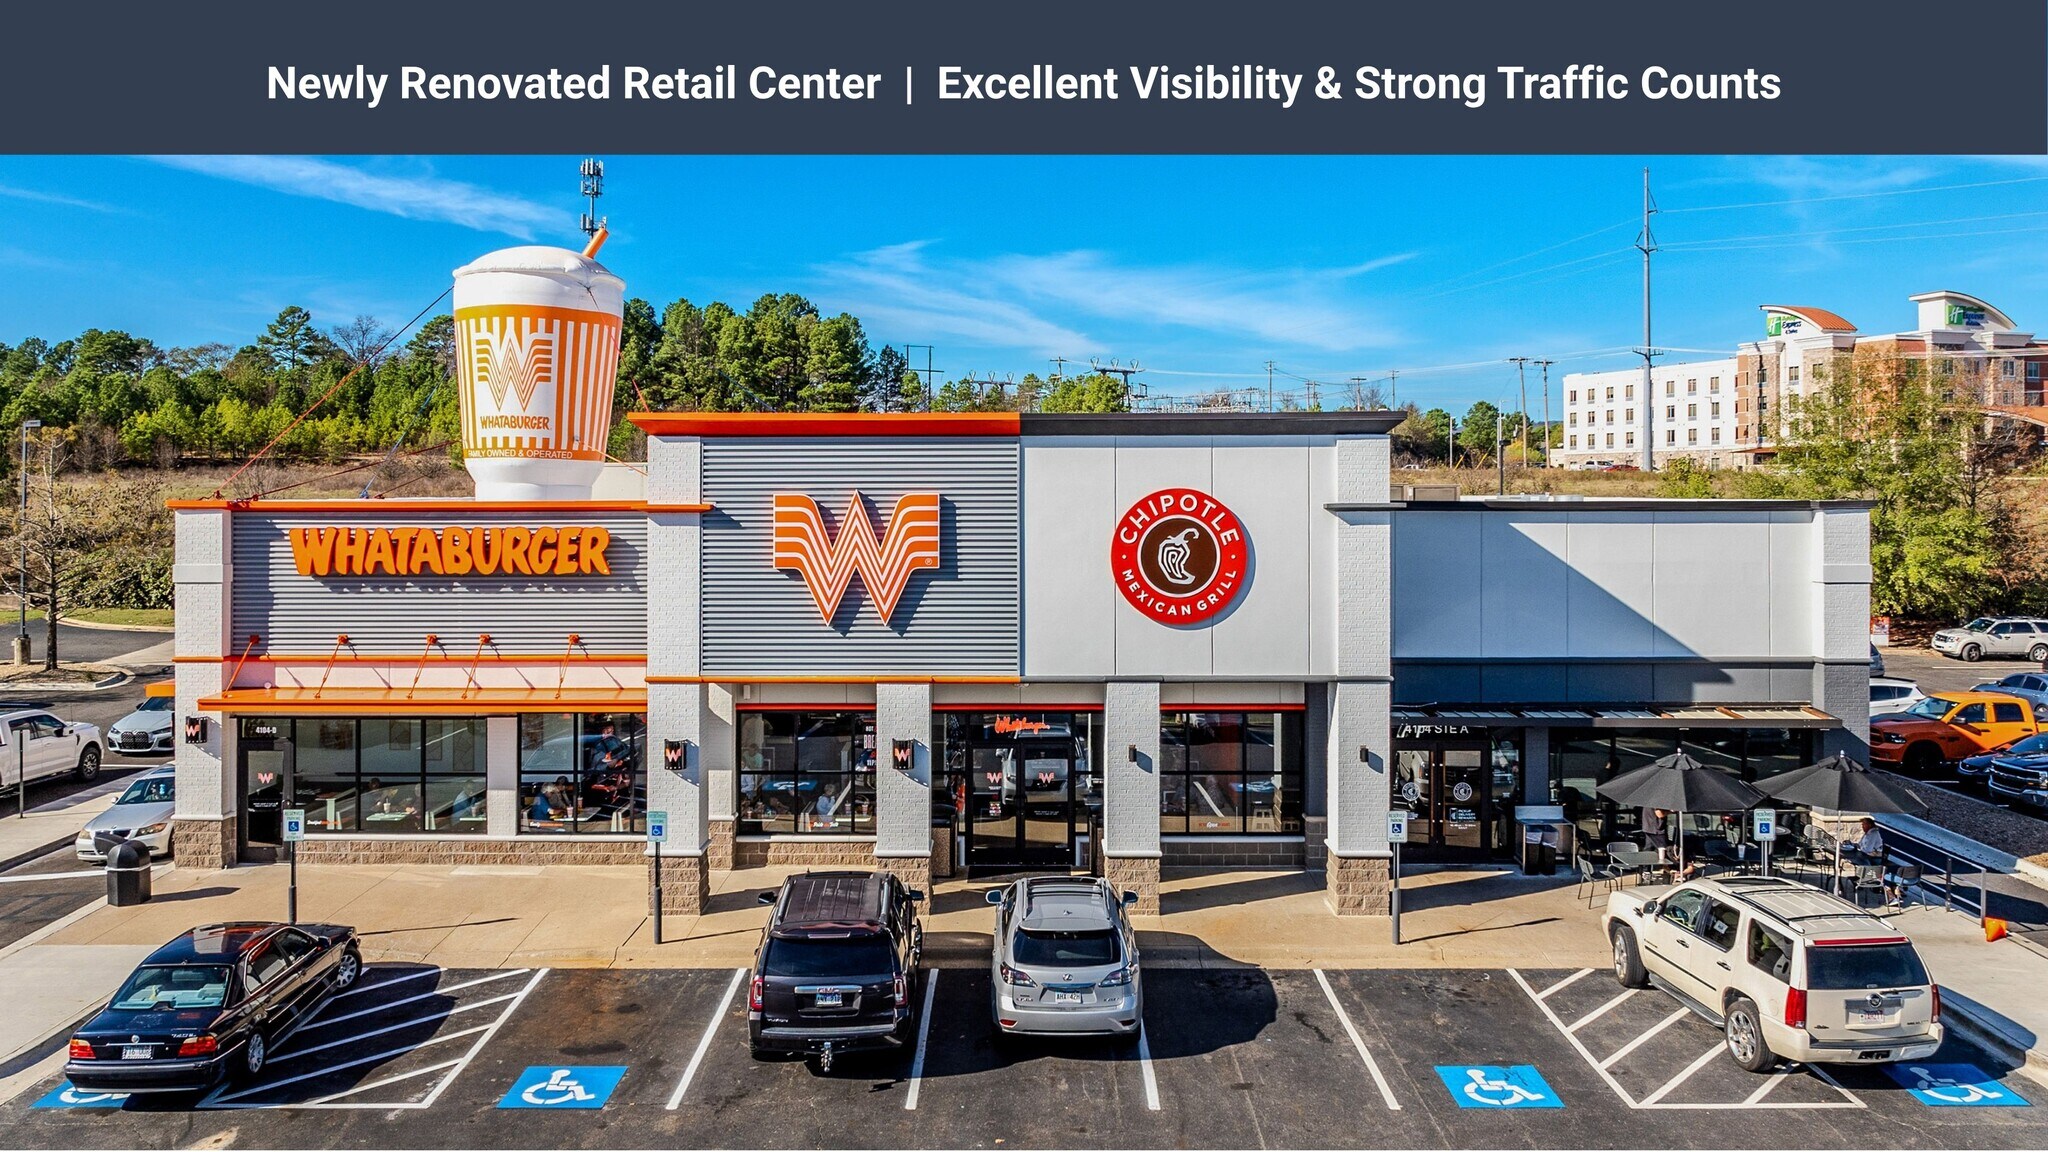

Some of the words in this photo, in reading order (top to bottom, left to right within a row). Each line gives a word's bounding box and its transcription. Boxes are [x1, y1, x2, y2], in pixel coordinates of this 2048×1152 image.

[480, 415, 551, 430] WHATABURGER
[468, 449, 486, 458] FAMILY
[486, 449, 516, 457] OWNED
[518, 449, 524, 457] &
[526, 449, 573, 459] OPERATED
[1119, 494, 1240, 546] CHIPOTLE
[289, 526, 611, 576] WHATABURGER
[1121, 568, 1192, 616] MEXICAN
[1196, 569, 1238, 612] GRILL
